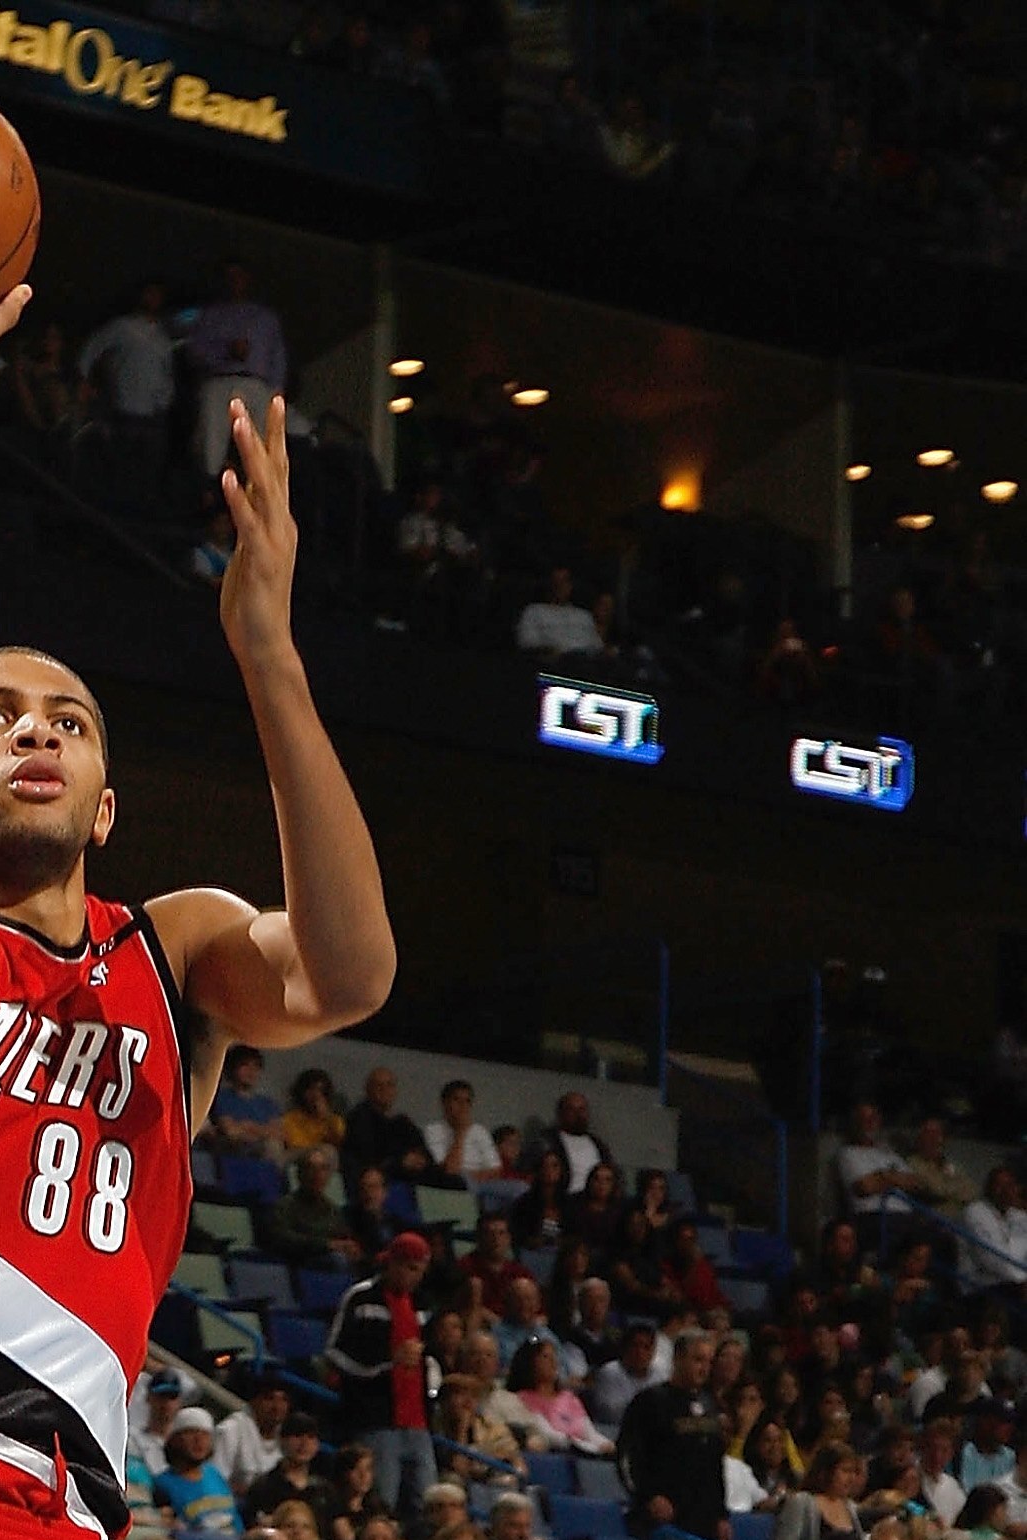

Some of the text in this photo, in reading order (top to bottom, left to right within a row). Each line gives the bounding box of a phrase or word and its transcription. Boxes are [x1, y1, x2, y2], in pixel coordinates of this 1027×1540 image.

[170, 73, 289, 143] Bank
[541, 686, 658, 748] CST
[790, 738, 902, 798] CST
[25, 1121, 133, 1253] 88
